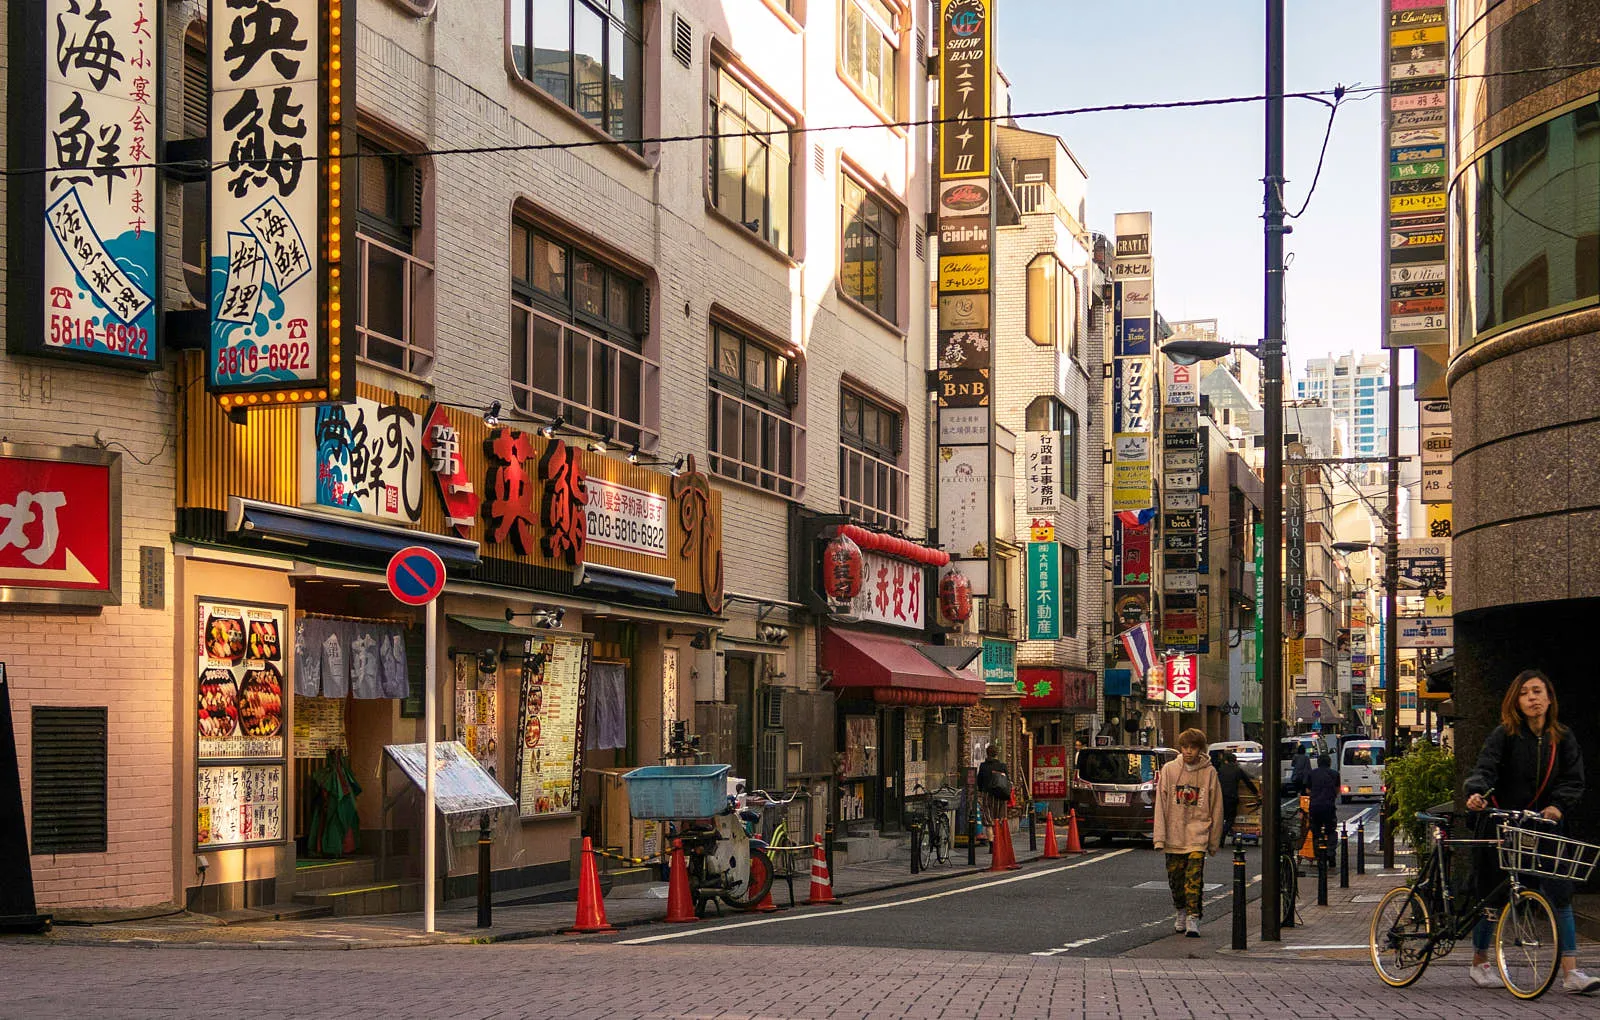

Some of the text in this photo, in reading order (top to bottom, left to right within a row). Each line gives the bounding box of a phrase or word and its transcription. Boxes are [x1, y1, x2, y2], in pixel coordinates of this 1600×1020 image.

[947, 38, 981, 49] SHOW
[949, 50, 983, 61] BAND
[50, 0, 128, 204] 海鮮
[1399, 196, 1442, 207] わいわい
[255, 208, 305, 285] 海鮮
[1117, 239, 1148, 252] GRATIA
[1408, 234, 1443, 245] EDEN
[54, 202, 145, 319] 活魚料理
[222, 240, 264, 318] 料理
[1115, 263, 1150, 275] 信水ビル
[945, 277, 985, 288] チャレンジ
[49, 315, 149, 356] 5816-6922
[218, 341, 310, 375] 5816-6922
[944, 382, 985, 397] BNB
[1129, 362, 1143, 428] クリスタル
[316, 405, 387, 516] 海鮮
[1030, 451, 1039, 494] ダイモン
[1040, 434, 1053, 506] 行政書士事務所
[589, 488, 664, 522] 大小宴会予約承ります
[1171, 519, 1191, 528] brat
[1289, 473, 1301, 569] CENTURION
[598, 513, 664, 550] 03-5816-6922
[874, 563, 921, 625] 赤提灯
[1036, 589, 1052, 634] 不動産
[1289, 573, 1301, 632] HOTEL
[272, 767, 280, 801] 赤貝
